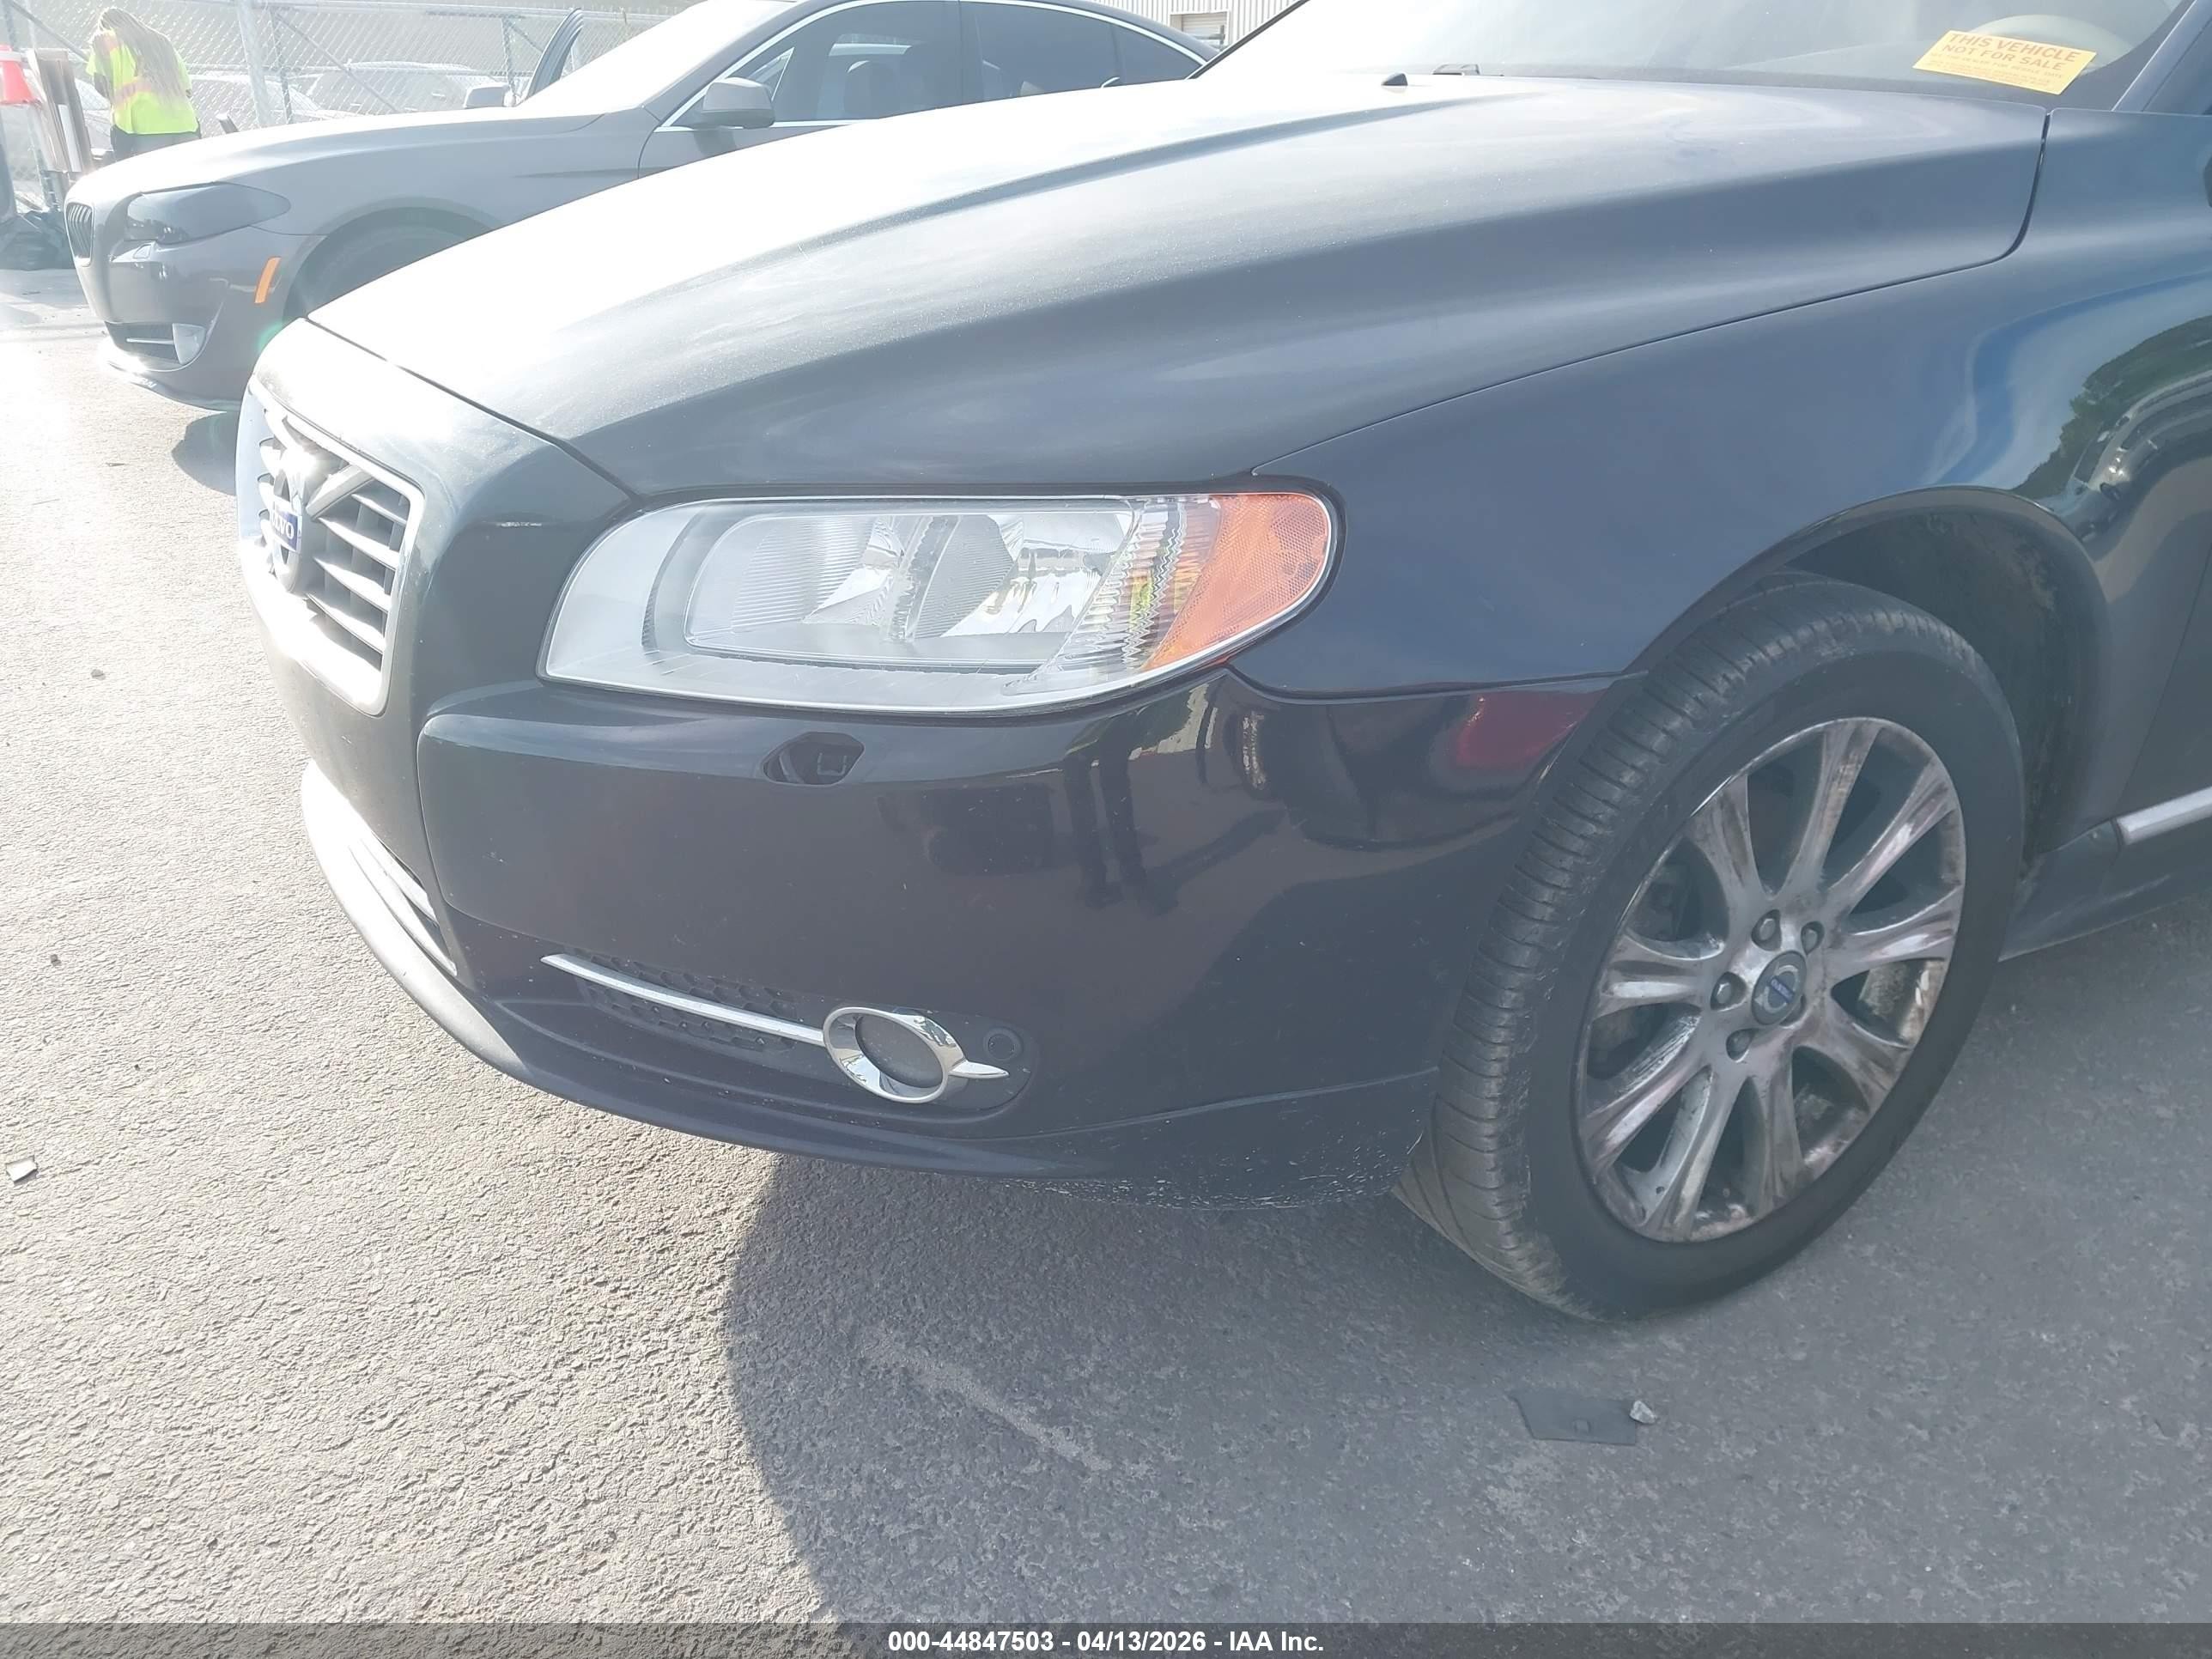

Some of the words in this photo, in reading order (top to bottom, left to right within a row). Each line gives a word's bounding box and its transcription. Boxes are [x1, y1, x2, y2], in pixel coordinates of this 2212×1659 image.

[1942, 44, 1978, 55] NOT
[1980, 50, 2016, 62] FOR
[2019, 56, 2066, 70] SALE
[1949, 33, 1993, 47] THIS
[1996, 40, 2081, 62] VEHICLE
